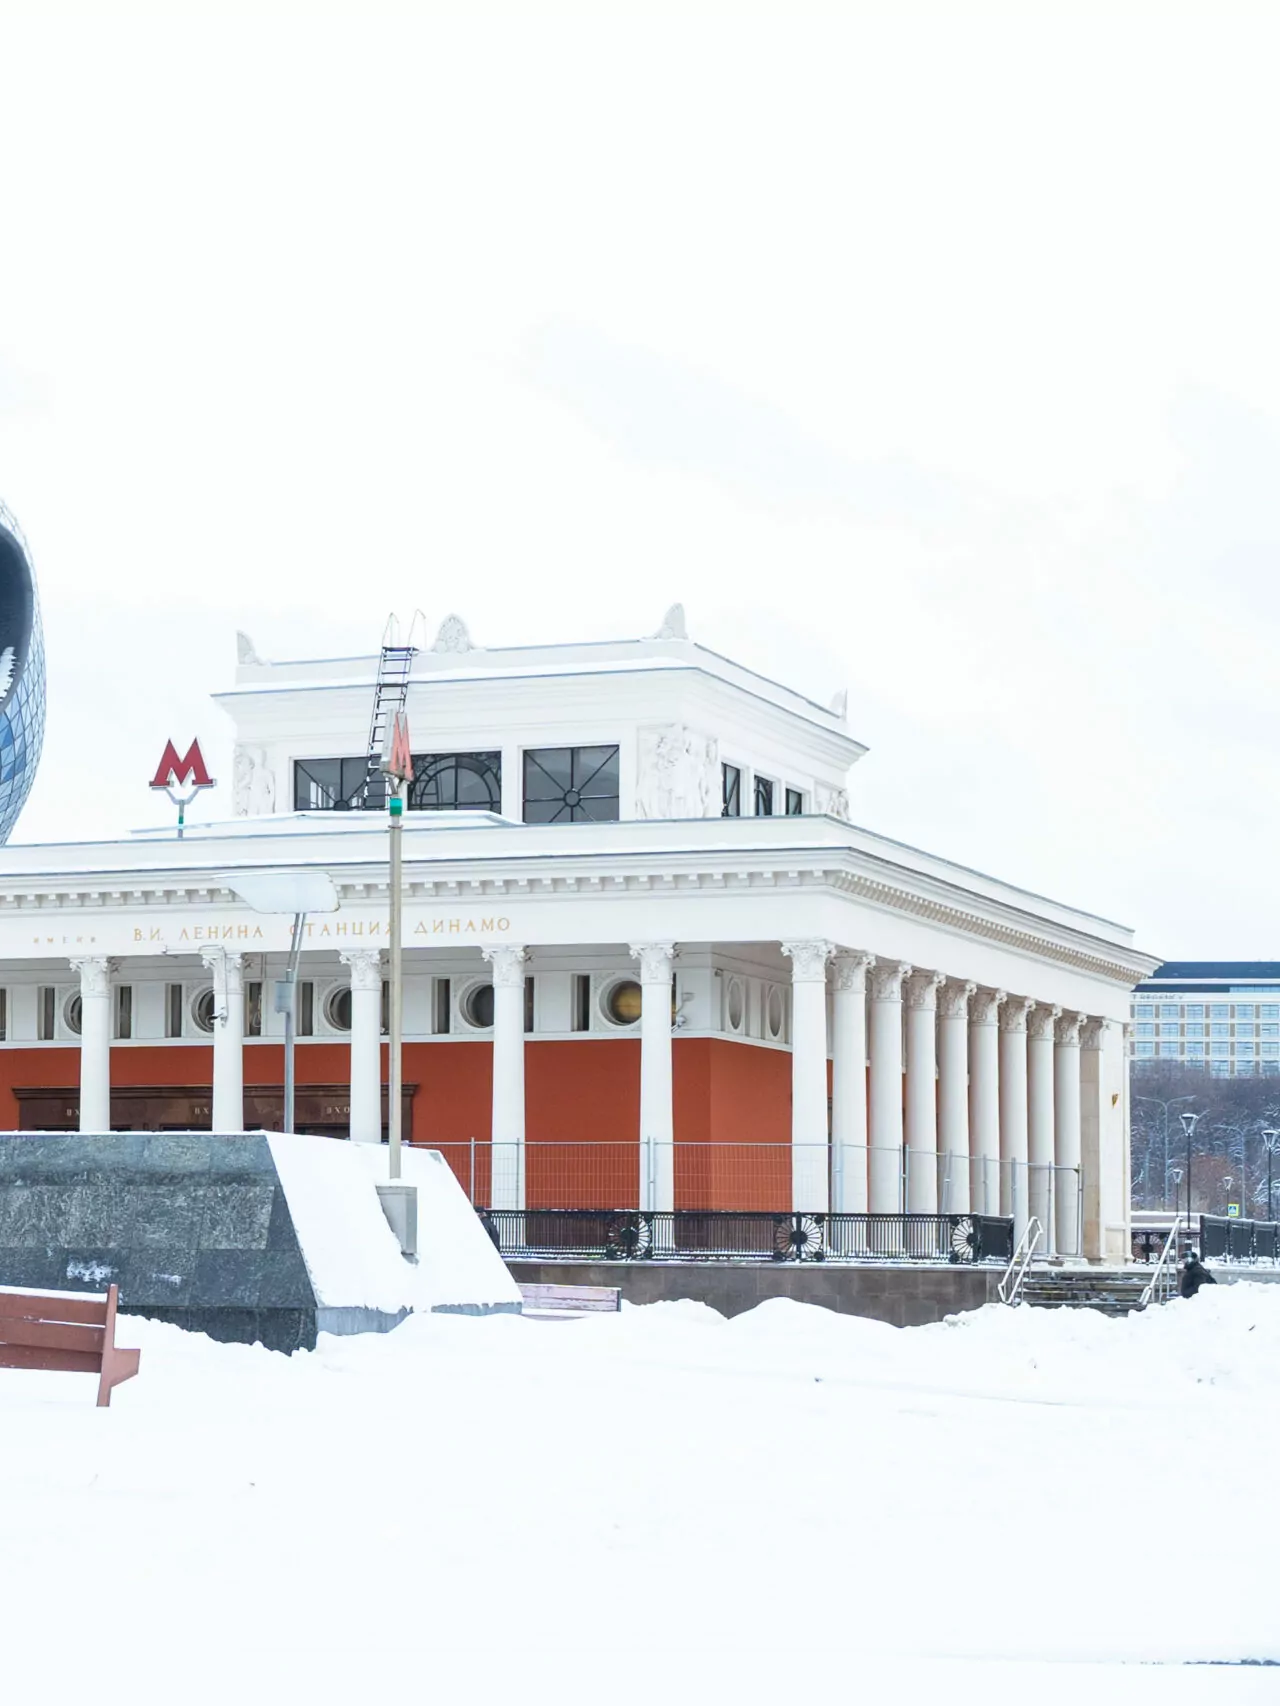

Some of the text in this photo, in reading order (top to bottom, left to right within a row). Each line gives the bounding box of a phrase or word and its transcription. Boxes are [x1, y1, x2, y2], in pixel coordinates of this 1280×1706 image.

[148, 736, 216, 787] М
[179, 926, 263, 940] ЛЕНИНА
[414, 917, 511, 934] ДИНАМО
[326, 1106, 350, 1115] ВХО
